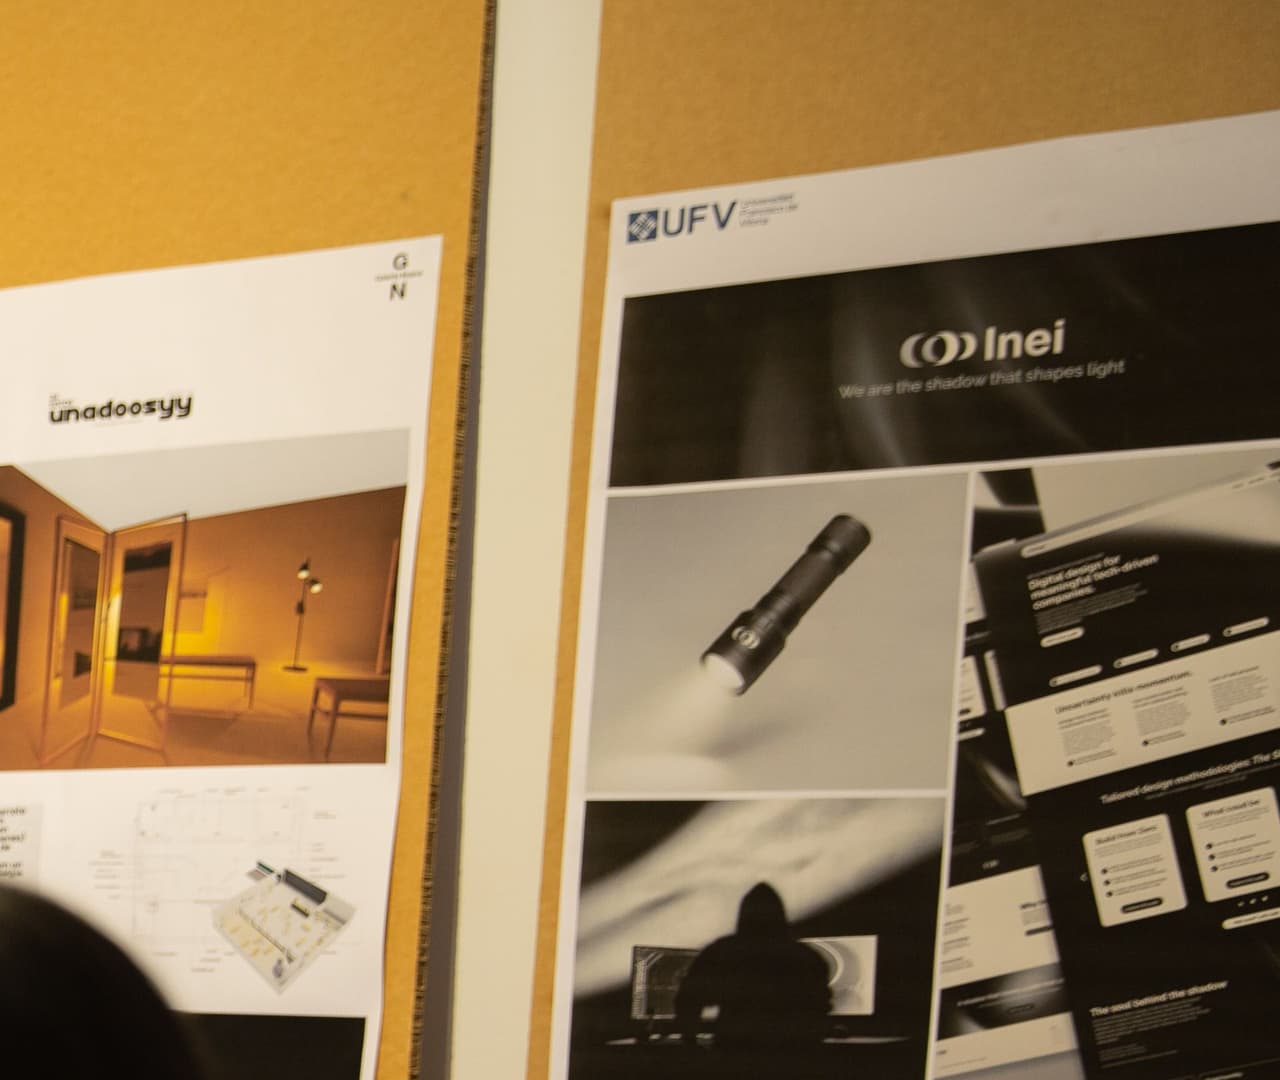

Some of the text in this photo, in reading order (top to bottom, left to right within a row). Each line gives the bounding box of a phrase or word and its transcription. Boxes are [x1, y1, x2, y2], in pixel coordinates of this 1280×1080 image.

[663, 201, 737, 237] UFV
[392, 252, 407, 271] G
[389, 281, 407, 301] N
[983, 318, 1066, 361] Inei
[839, 359, 1126, 399] We are the shadow that shapes light
